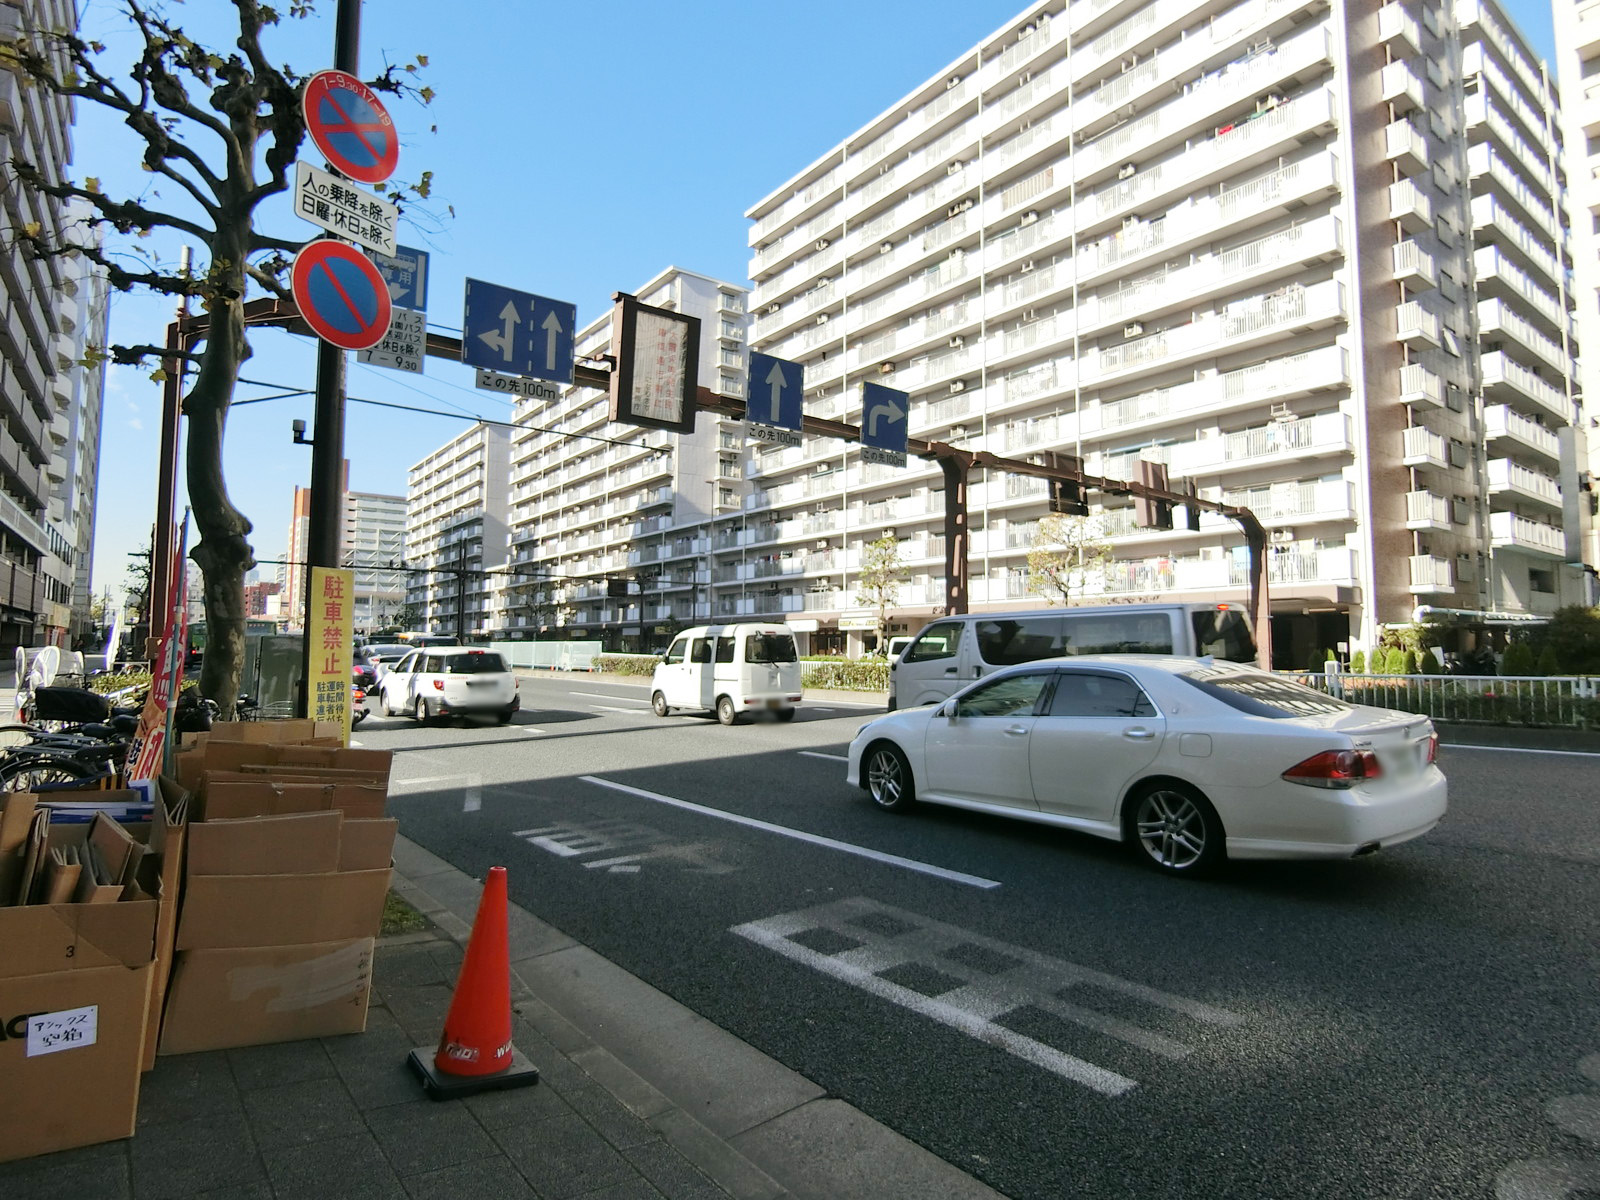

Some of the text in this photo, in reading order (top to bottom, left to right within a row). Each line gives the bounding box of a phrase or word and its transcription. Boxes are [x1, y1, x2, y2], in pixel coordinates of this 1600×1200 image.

[302, 172, 393, 229] 人の乗降を除く
[302, 194, 391, 250] 日曜・休日を除く
[482, 375, 556, 399] この先100m
[749, 427, 800, 446] この先100m
[322, 575, 345, 675] 駐車禁止
[66, 945, 76, 958] 3
[34, 1014, 89, 1033] アシックス
[42, 1027, 83, 1048] 空箱
